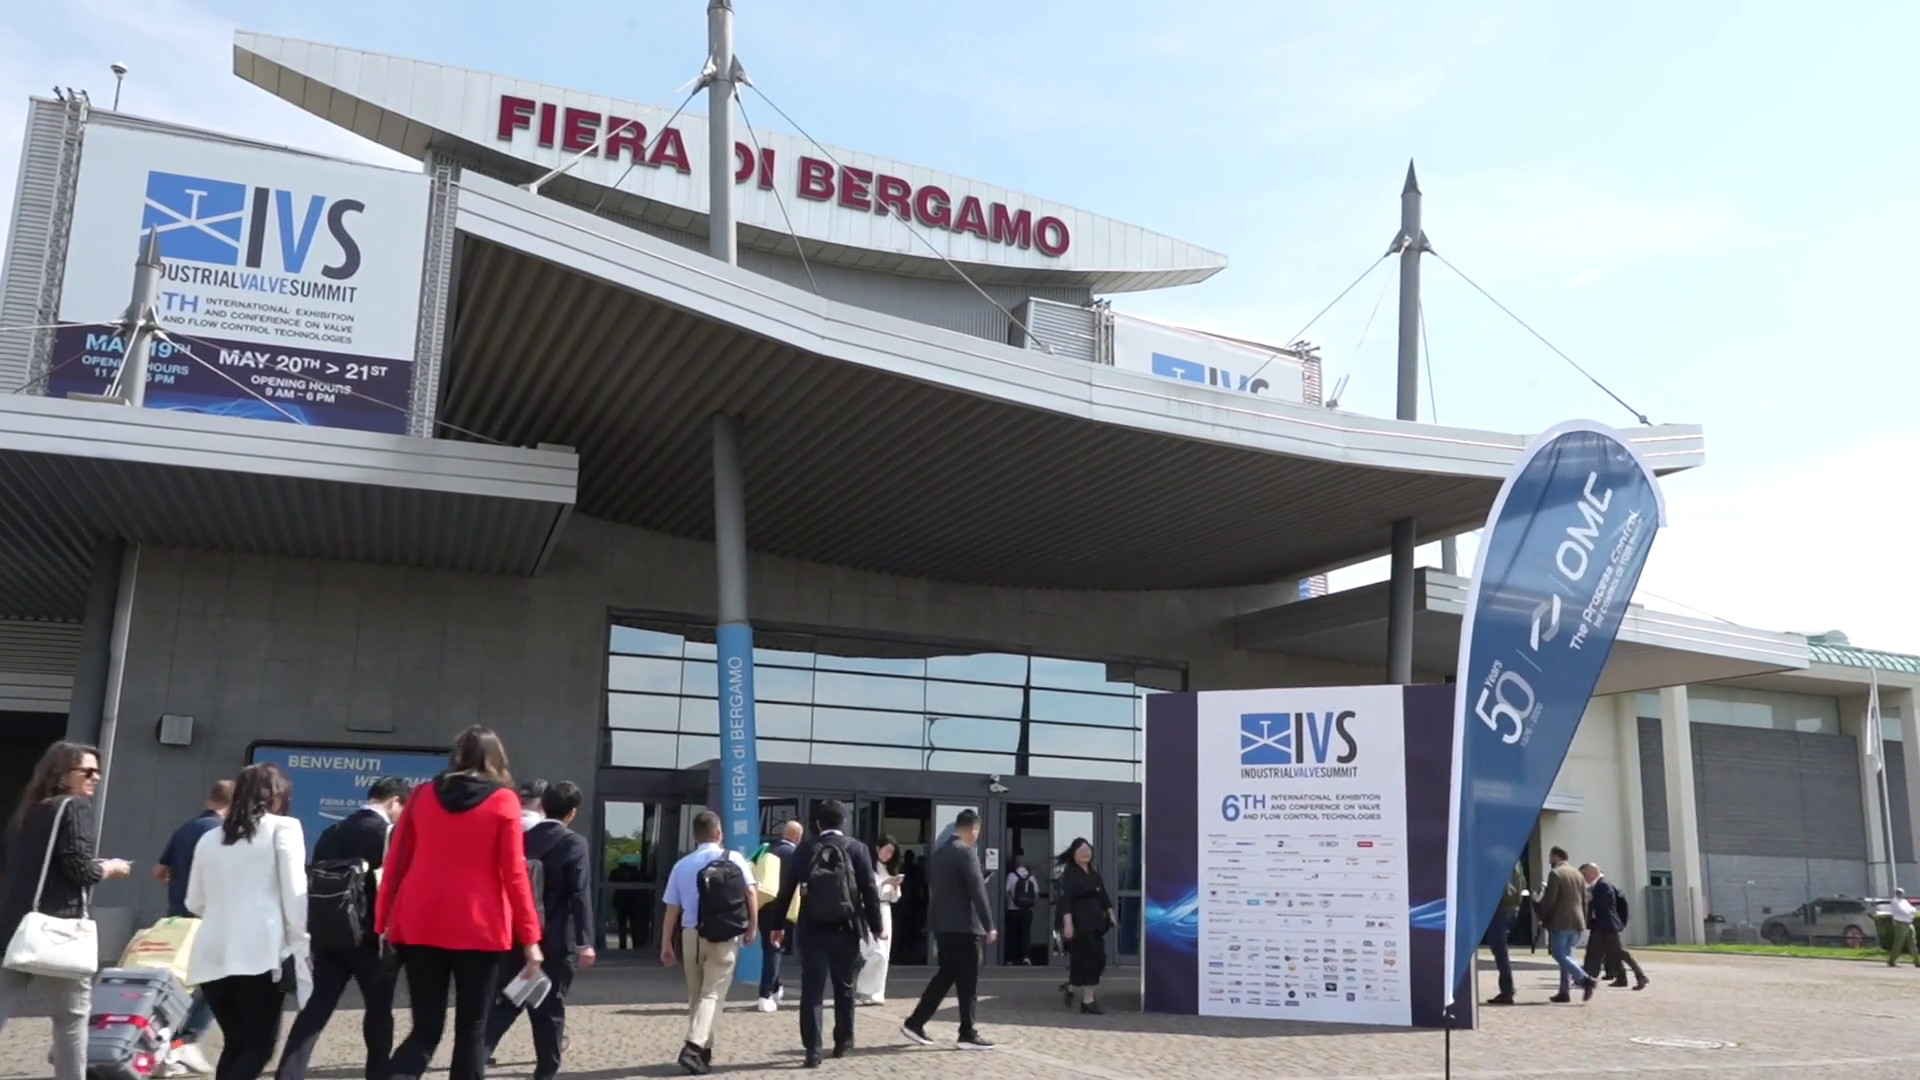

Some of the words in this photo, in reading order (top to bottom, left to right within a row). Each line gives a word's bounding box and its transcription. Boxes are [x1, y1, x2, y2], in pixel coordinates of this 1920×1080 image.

[498, 95, 692, 175] FIERA
[735, 141, 776, 192] DI
[797, 155, 1071, 258] BERGAMO
[246, 186, 366, 281] IVS
[160, 262, 358, 304] DUSTRIALVALVESUMMIT
[156, 291, 199, 316] TH
[206, 297, 291, 314] INTERNATIONAL
[296, 307, 355, 323] EXHIBITION
[162, 314, 185, 325] AND
[188, 317, 218, 329] FLOW
[221, 321, 271, 335] CONTROL
[274, 328, 353, 345] TECHNOLOGIES
[204, 309, 227, 319] AND
[231, 311, 300, 327] CONFERENCE
[305, 321, 320, 330] ON
[324, 323, 353, 334] VALVE
[85, 333, 125, 355] MA
[81, 354, 121, 369] OPENI
[218, 349, 271, 369] MAY
[275, 355, 321, 373] 20TH
[345, 363, 388, 380] 21ST
[154, 373, 175, 384] PM
[250, 375, 306, 390] OPENING
[309, 381, 352, 395] HOURS
[265, 388, 273, 397] 9
[274, 388, 296, 399] AM
[306, 391, 314, 401] 6
[316, 392, 335, 403] PM
[1556, 471, 1613, 581] OMC
[1569, 623, 1589, 650] The
[1582, 565, 1614, 623] Process
[1485, 659, 1503, 688] Years
[728, 656, 744, 740] BERGAMO
[1475, 670, 1535, 745] 50
[1295, 710, 1358, 765] IVS
[288, 755, 381, 771] BENVENUTI
[732, 747, 746, 759] di
[1241, 766, 1358, 779] INDUSTRIALVALVESUMMIT
[732, 763, 747, 811] FIERA
[1221, 794, 1266, 822] 6TH
